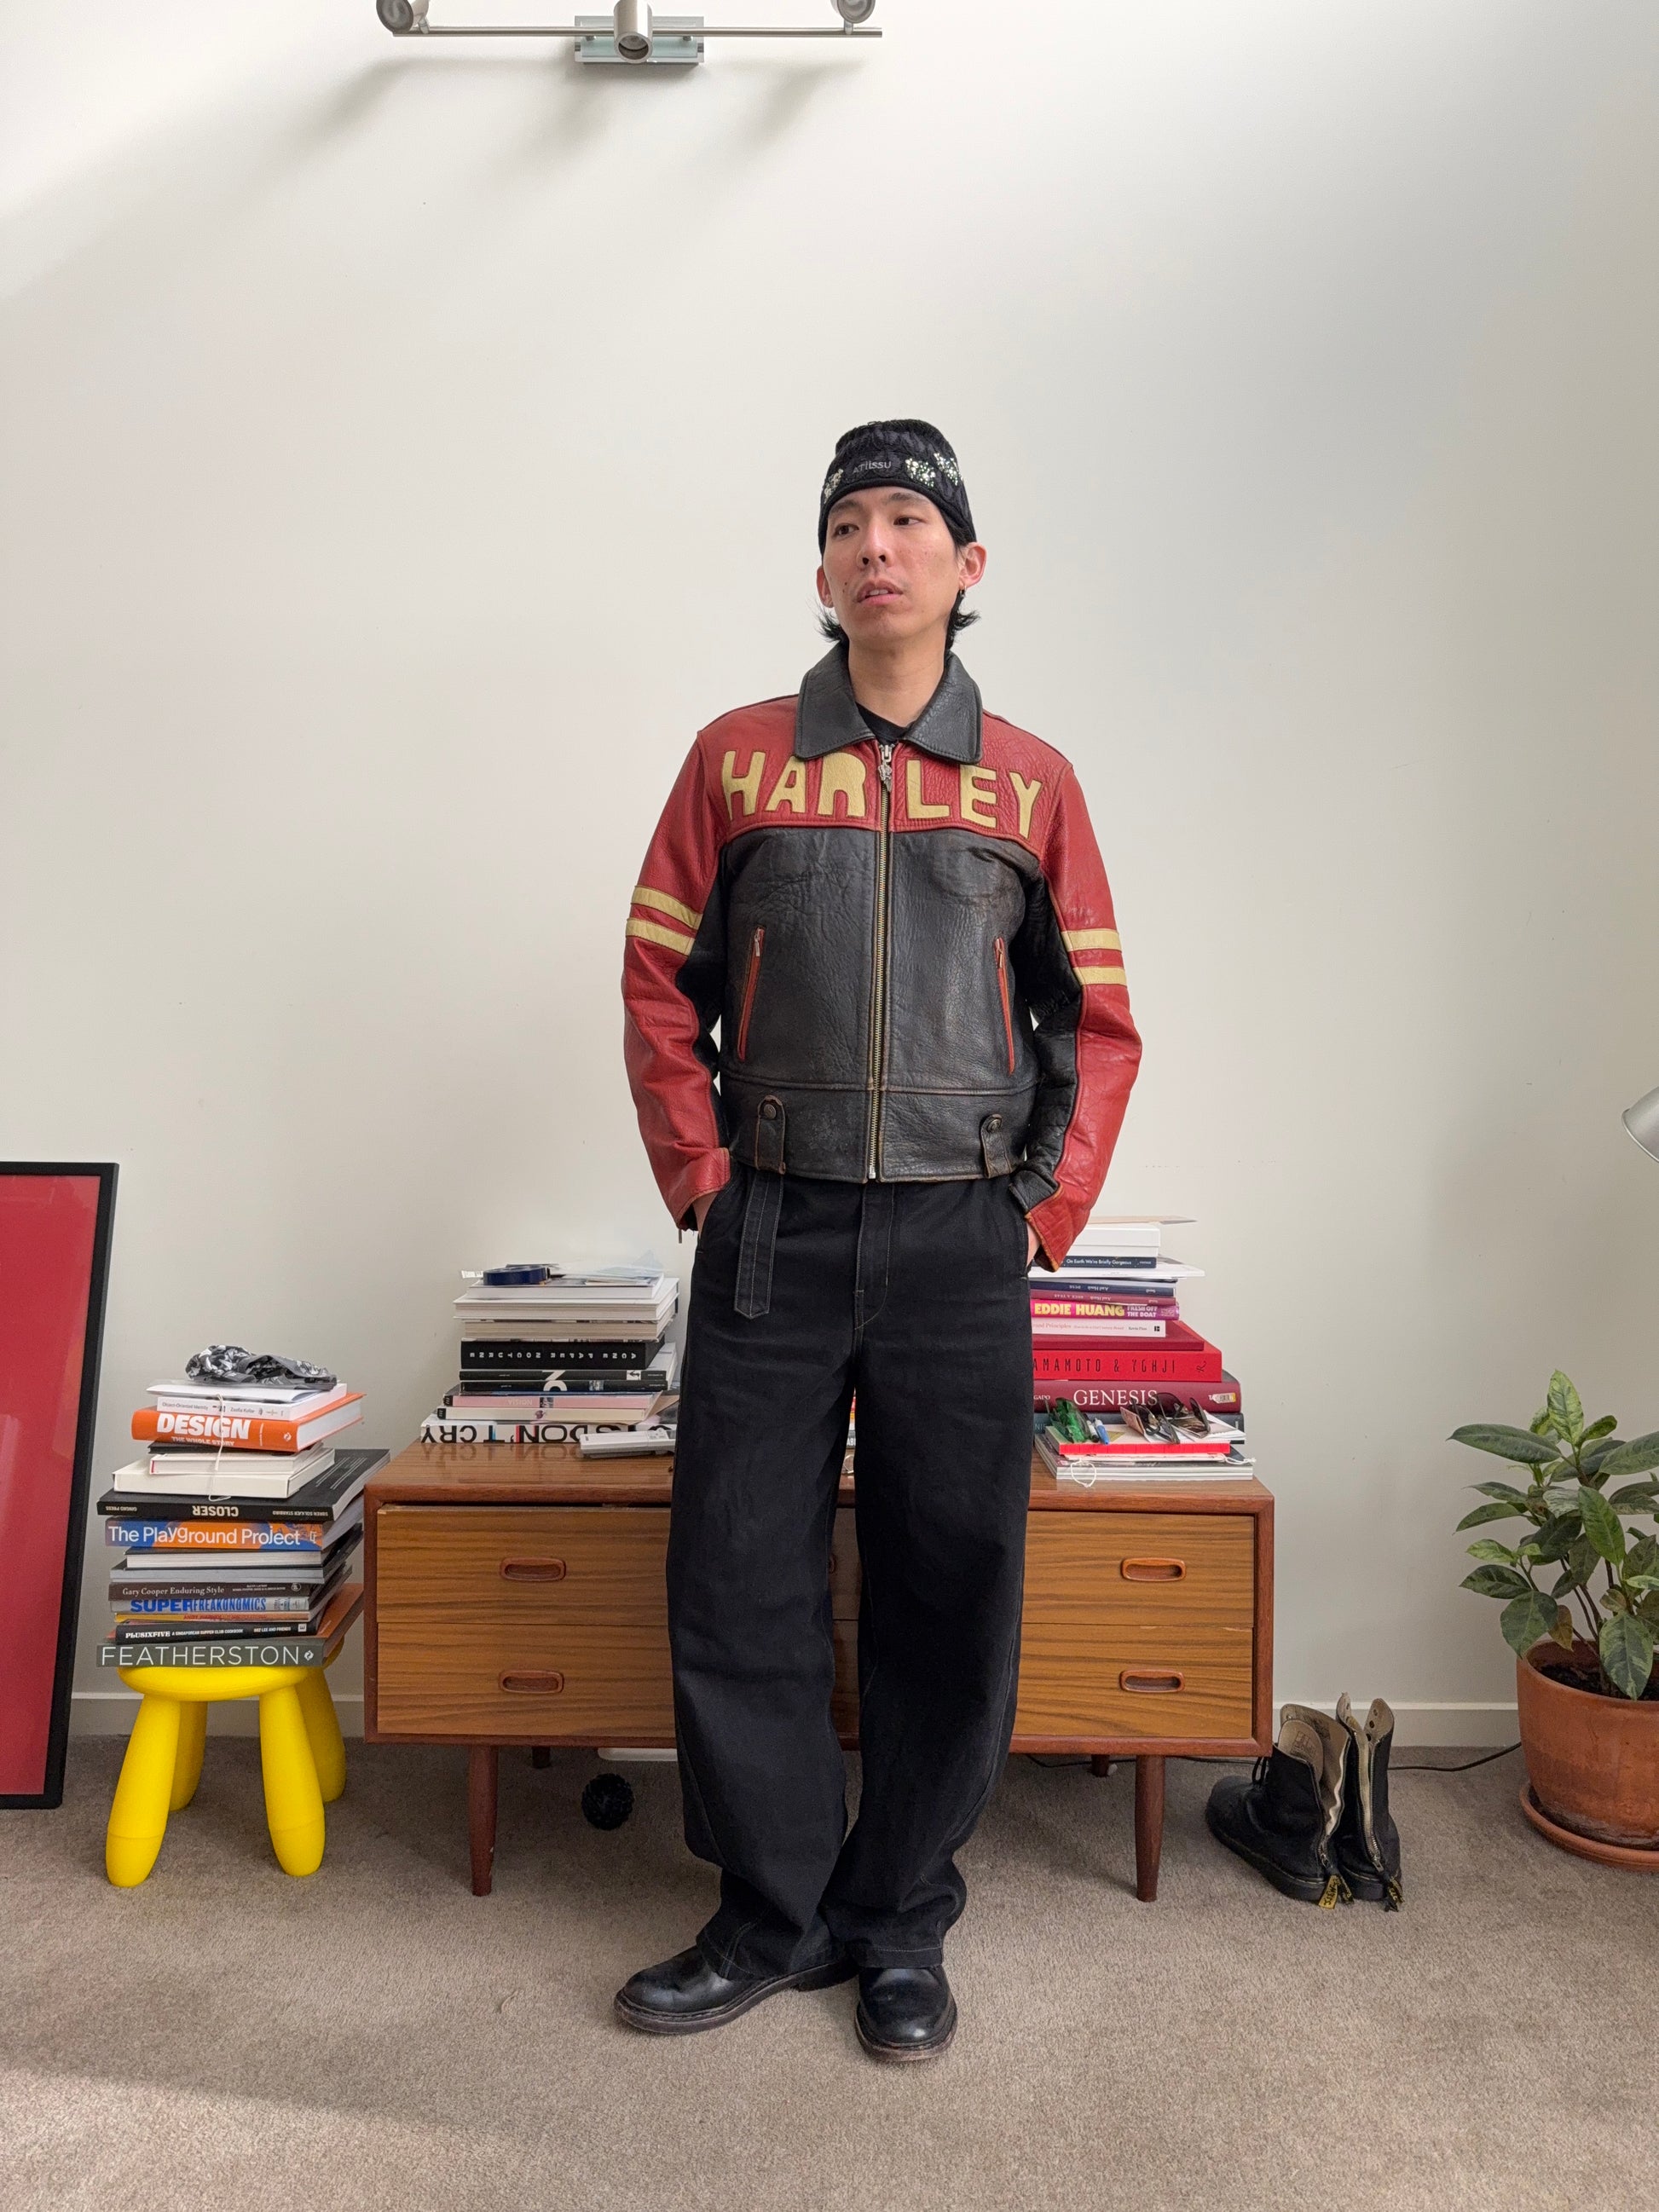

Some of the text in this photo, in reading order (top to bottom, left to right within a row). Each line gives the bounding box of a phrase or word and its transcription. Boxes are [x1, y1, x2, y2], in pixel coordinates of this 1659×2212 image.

[721, 750, 1043, 840] HARLEY
[1034, 1303, 1124, 1317] EDDIE HUANG
[1032, 1358, 1101, 1372] AMAMOTO
[1113, 1360, 1119, 1372] &
[1073, 1389, 1158, 1406] GENESIS
[157, 1412, 251, 1440] DESIGN
[421, 1424, 477, 1444] CRY
[192, 1505, 240, 1517] CLOSER
[108, 1526, 301, 1545] The Playground Project
[122, 1588, 140, 1597] Gary
[141, 1588, 169, 1597] Cooper
[170, 1586, 205, 1596] Enduring
[205, 1585, 225, 1595] Style
[102, 1646, 299, 1666] FEATHERSTON
